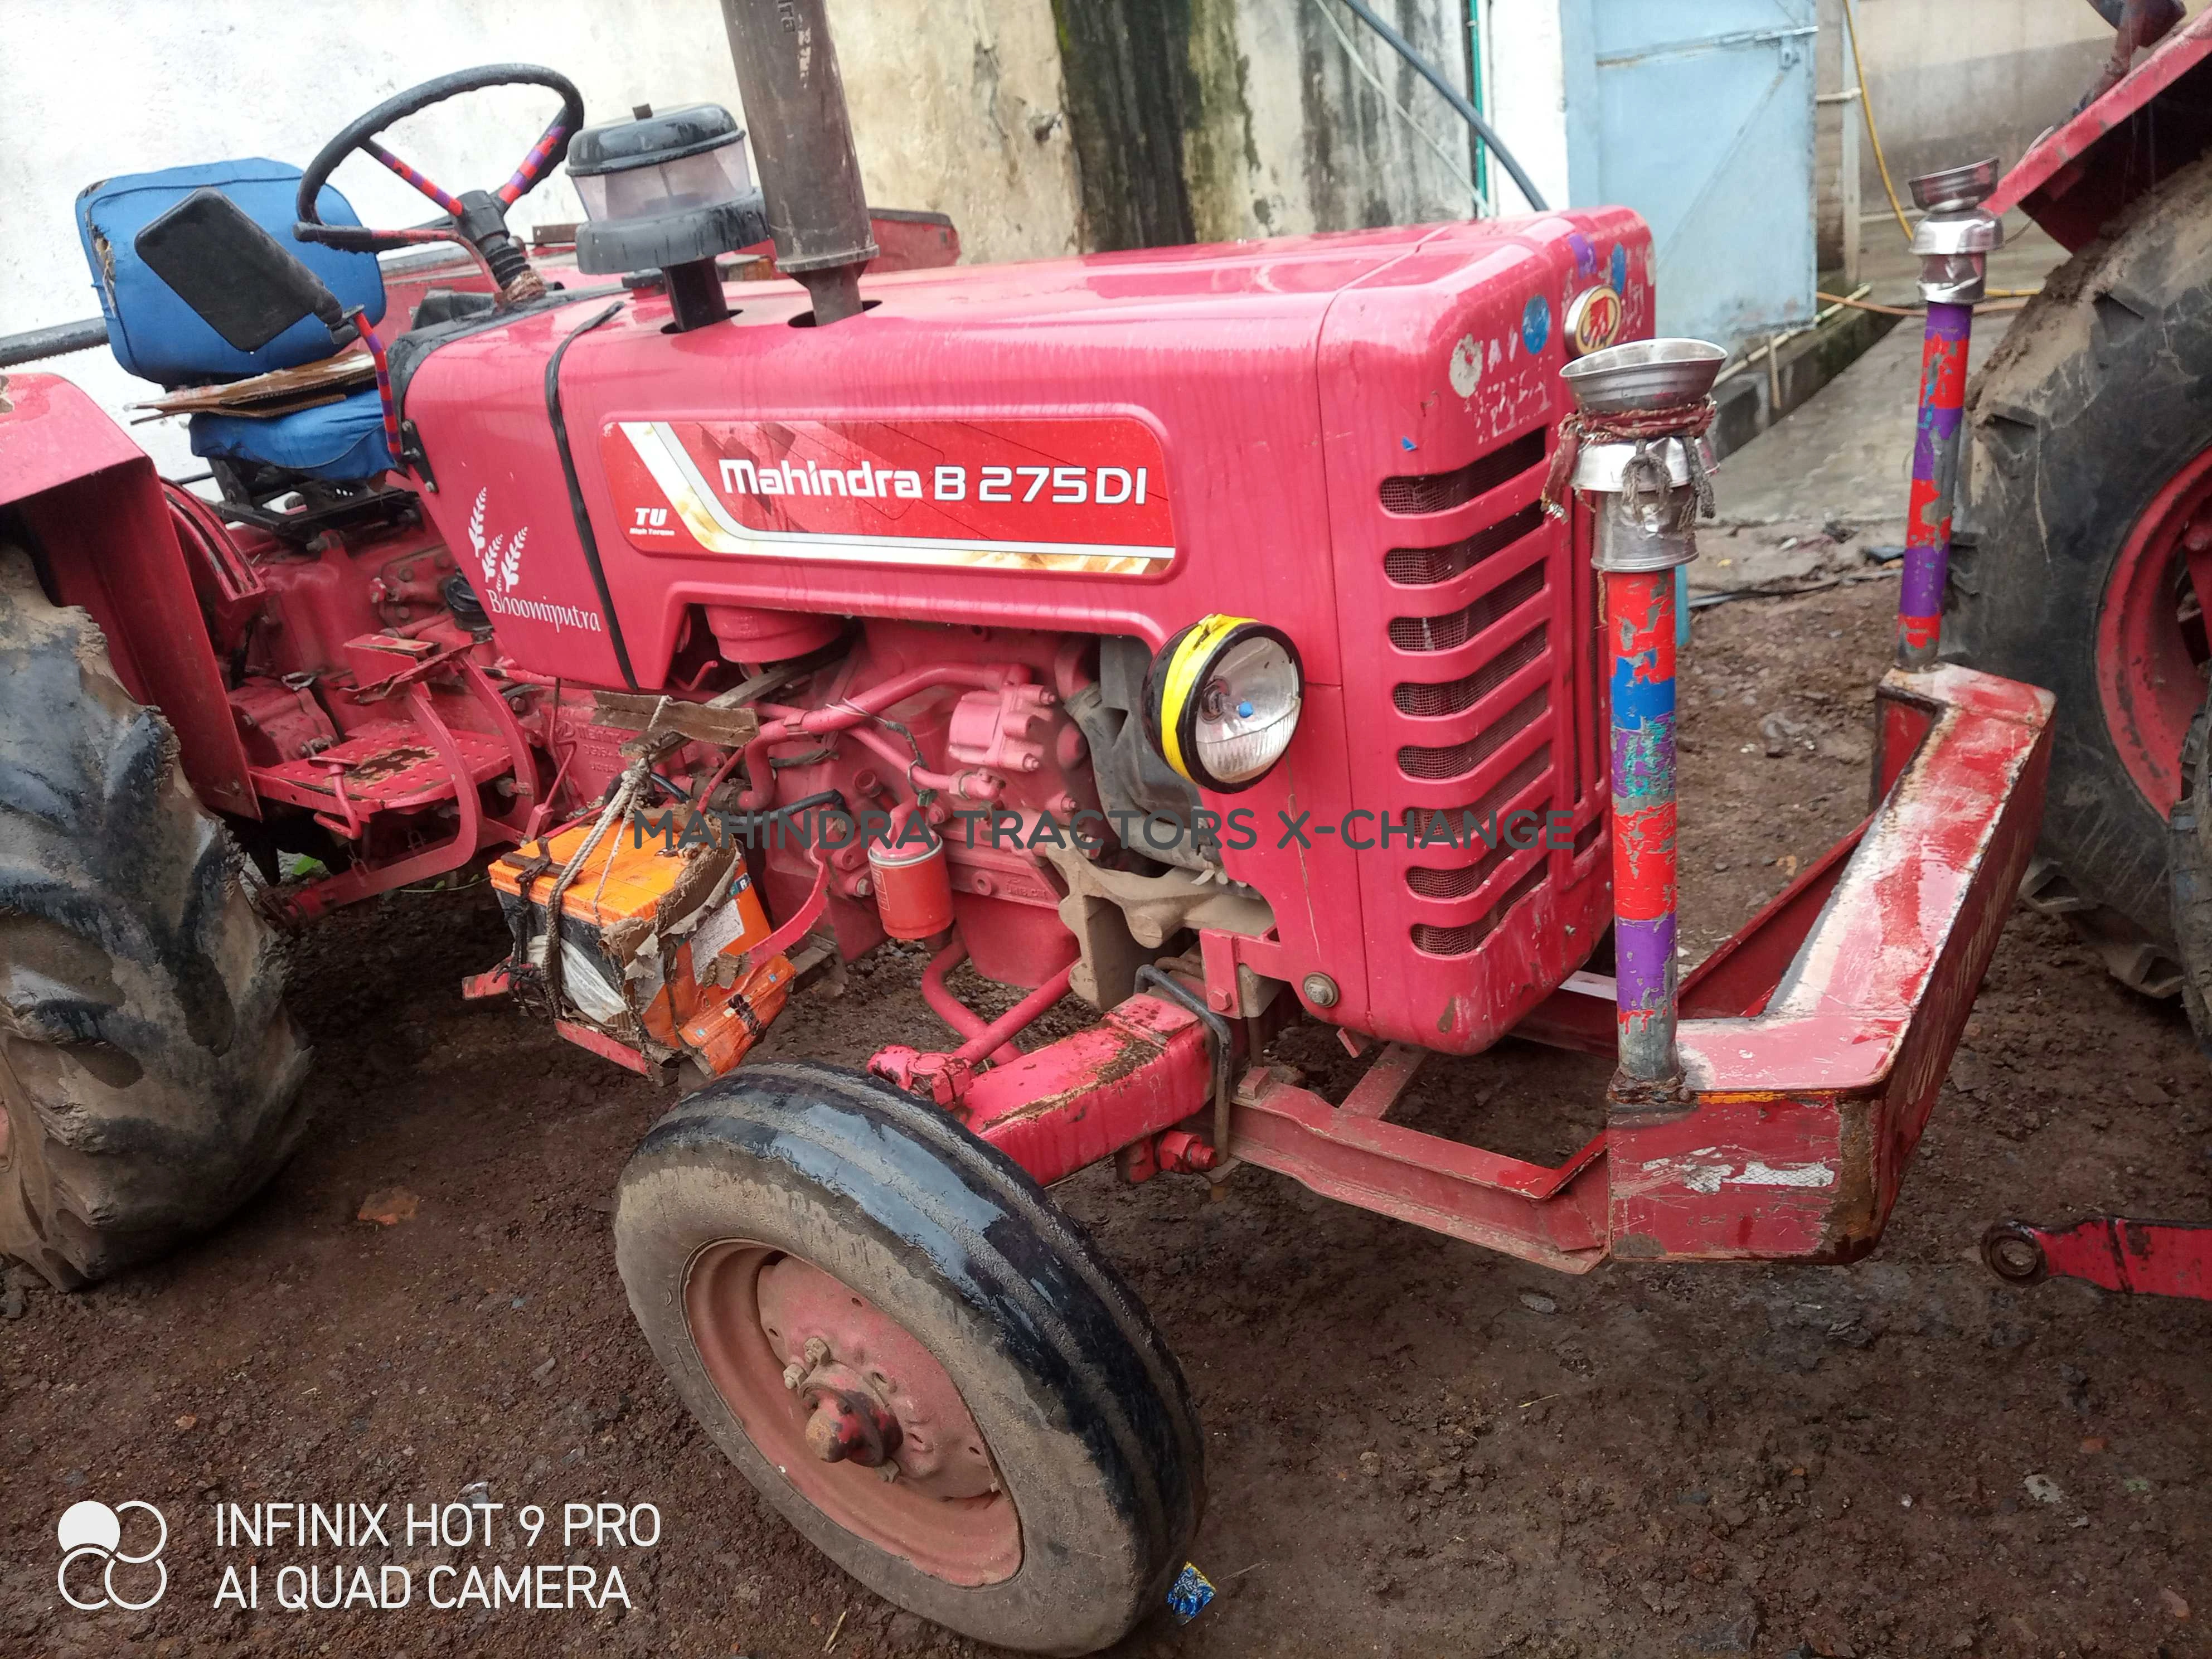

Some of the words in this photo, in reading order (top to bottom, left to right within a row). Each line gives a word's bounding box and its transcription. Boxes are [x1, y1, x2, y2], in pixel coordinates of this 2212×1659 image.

[718, 458, 923, 498] Mahindra
[934, 465, 966, 501] B
[635, 507, 667, 526] TU
[486, 588, 601, 633] Bhoomiputra
